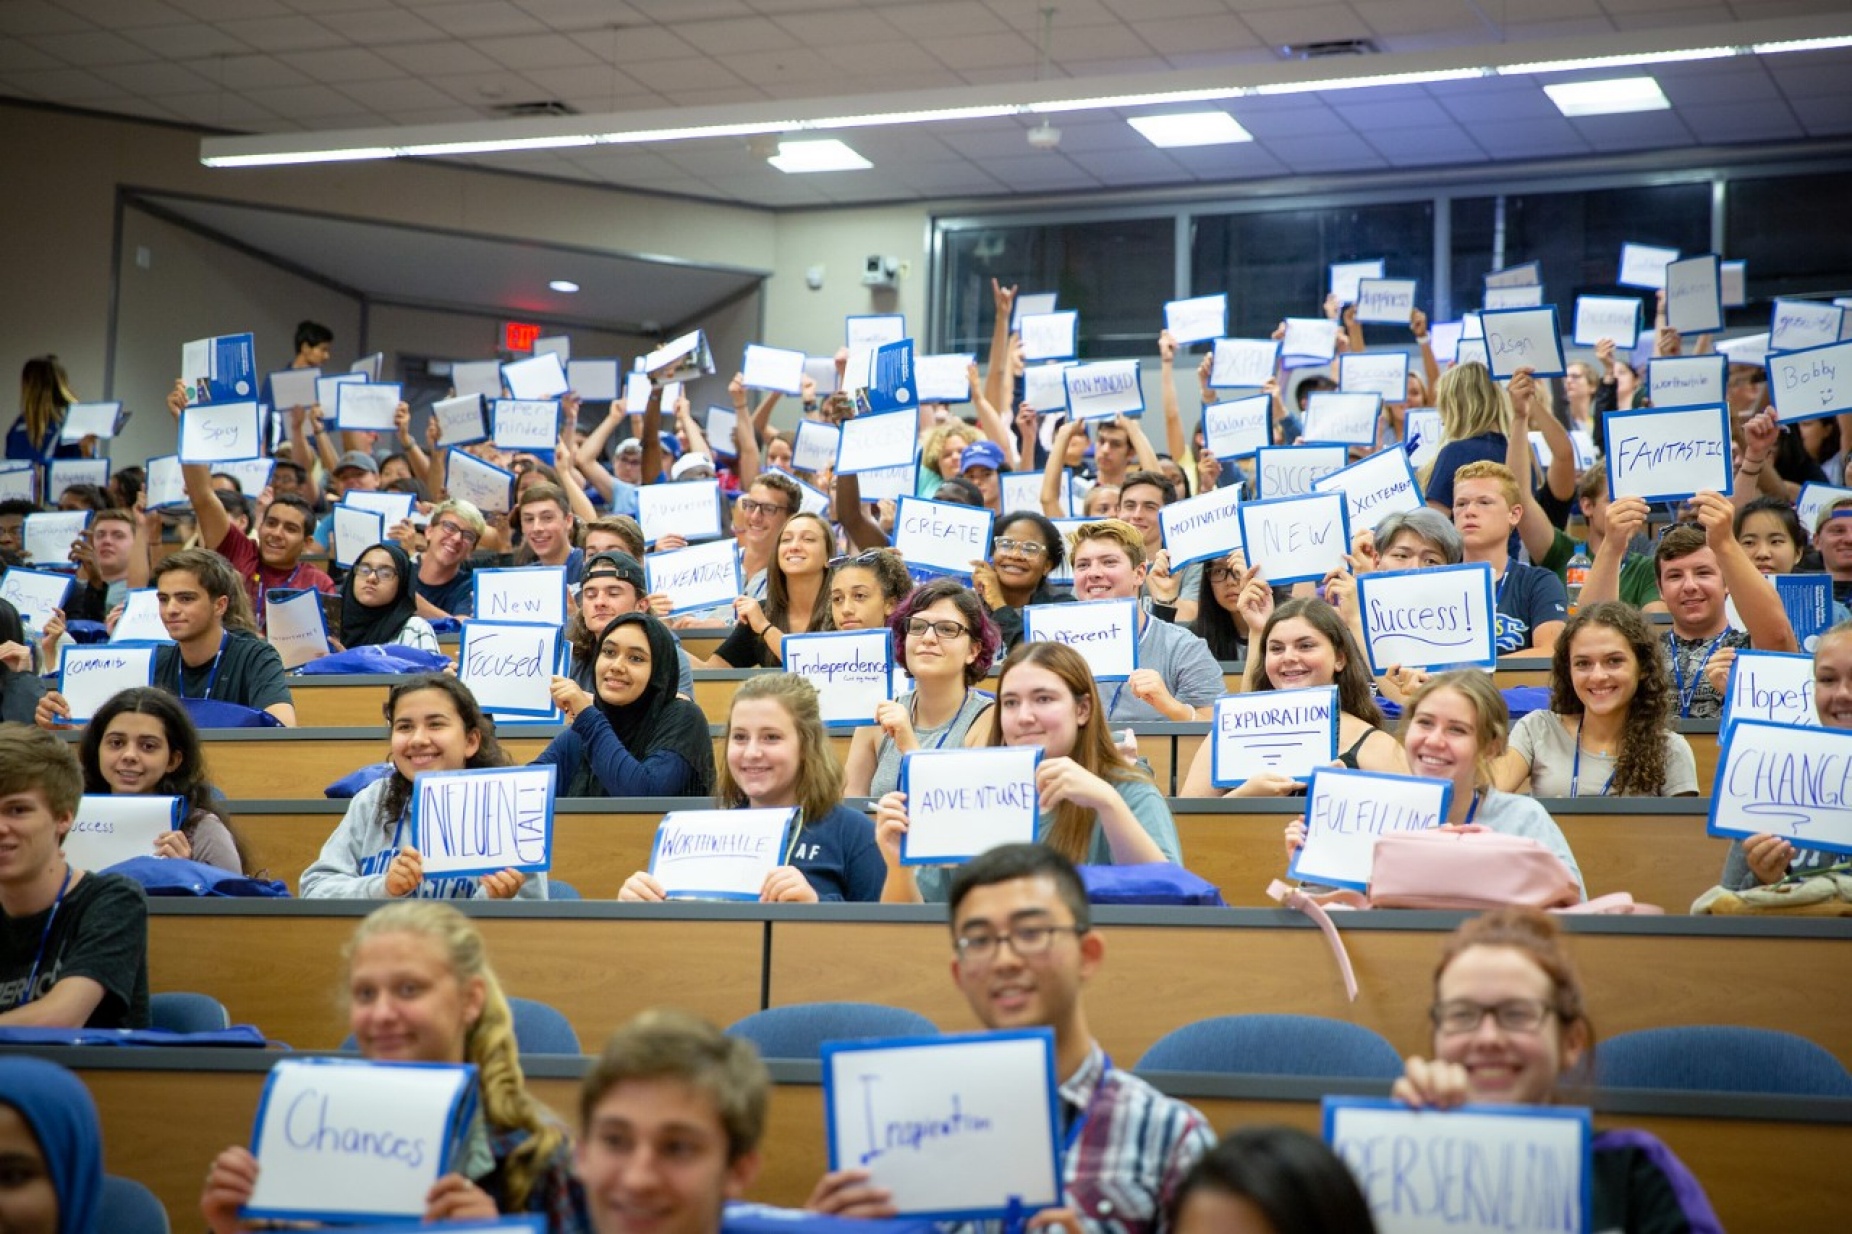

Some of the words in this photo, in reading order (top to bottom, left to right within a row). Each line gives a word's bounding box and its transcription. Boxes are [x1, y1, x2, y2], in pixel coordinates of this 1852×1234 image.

[1490, 332, 1535, 357] Design
[1782, 359, 1836, 390] Bobby
[1208, 412, 1265, 435] Balance
[1618, 436, 1723, 479] FANTASTIC
[905, 517, 979, 544] CREATE
[1263, 518, 1332, 556] NEW
[491, 591, 542, 614] New
[1370, 591, 1473, 633] Success!
[464, 633, 545, 680] Focused
[789, 647, 889, 684] Independence
[1221, 704, 1330, 732] EXPLORATION
[921, 781, 1034, 814] ADVENTURE
[661, 826, 771, 857] WORTHWHILE
[284, 1088, 427, 1169] Chances
[858, 1074, 993, 1166] Inspiration
